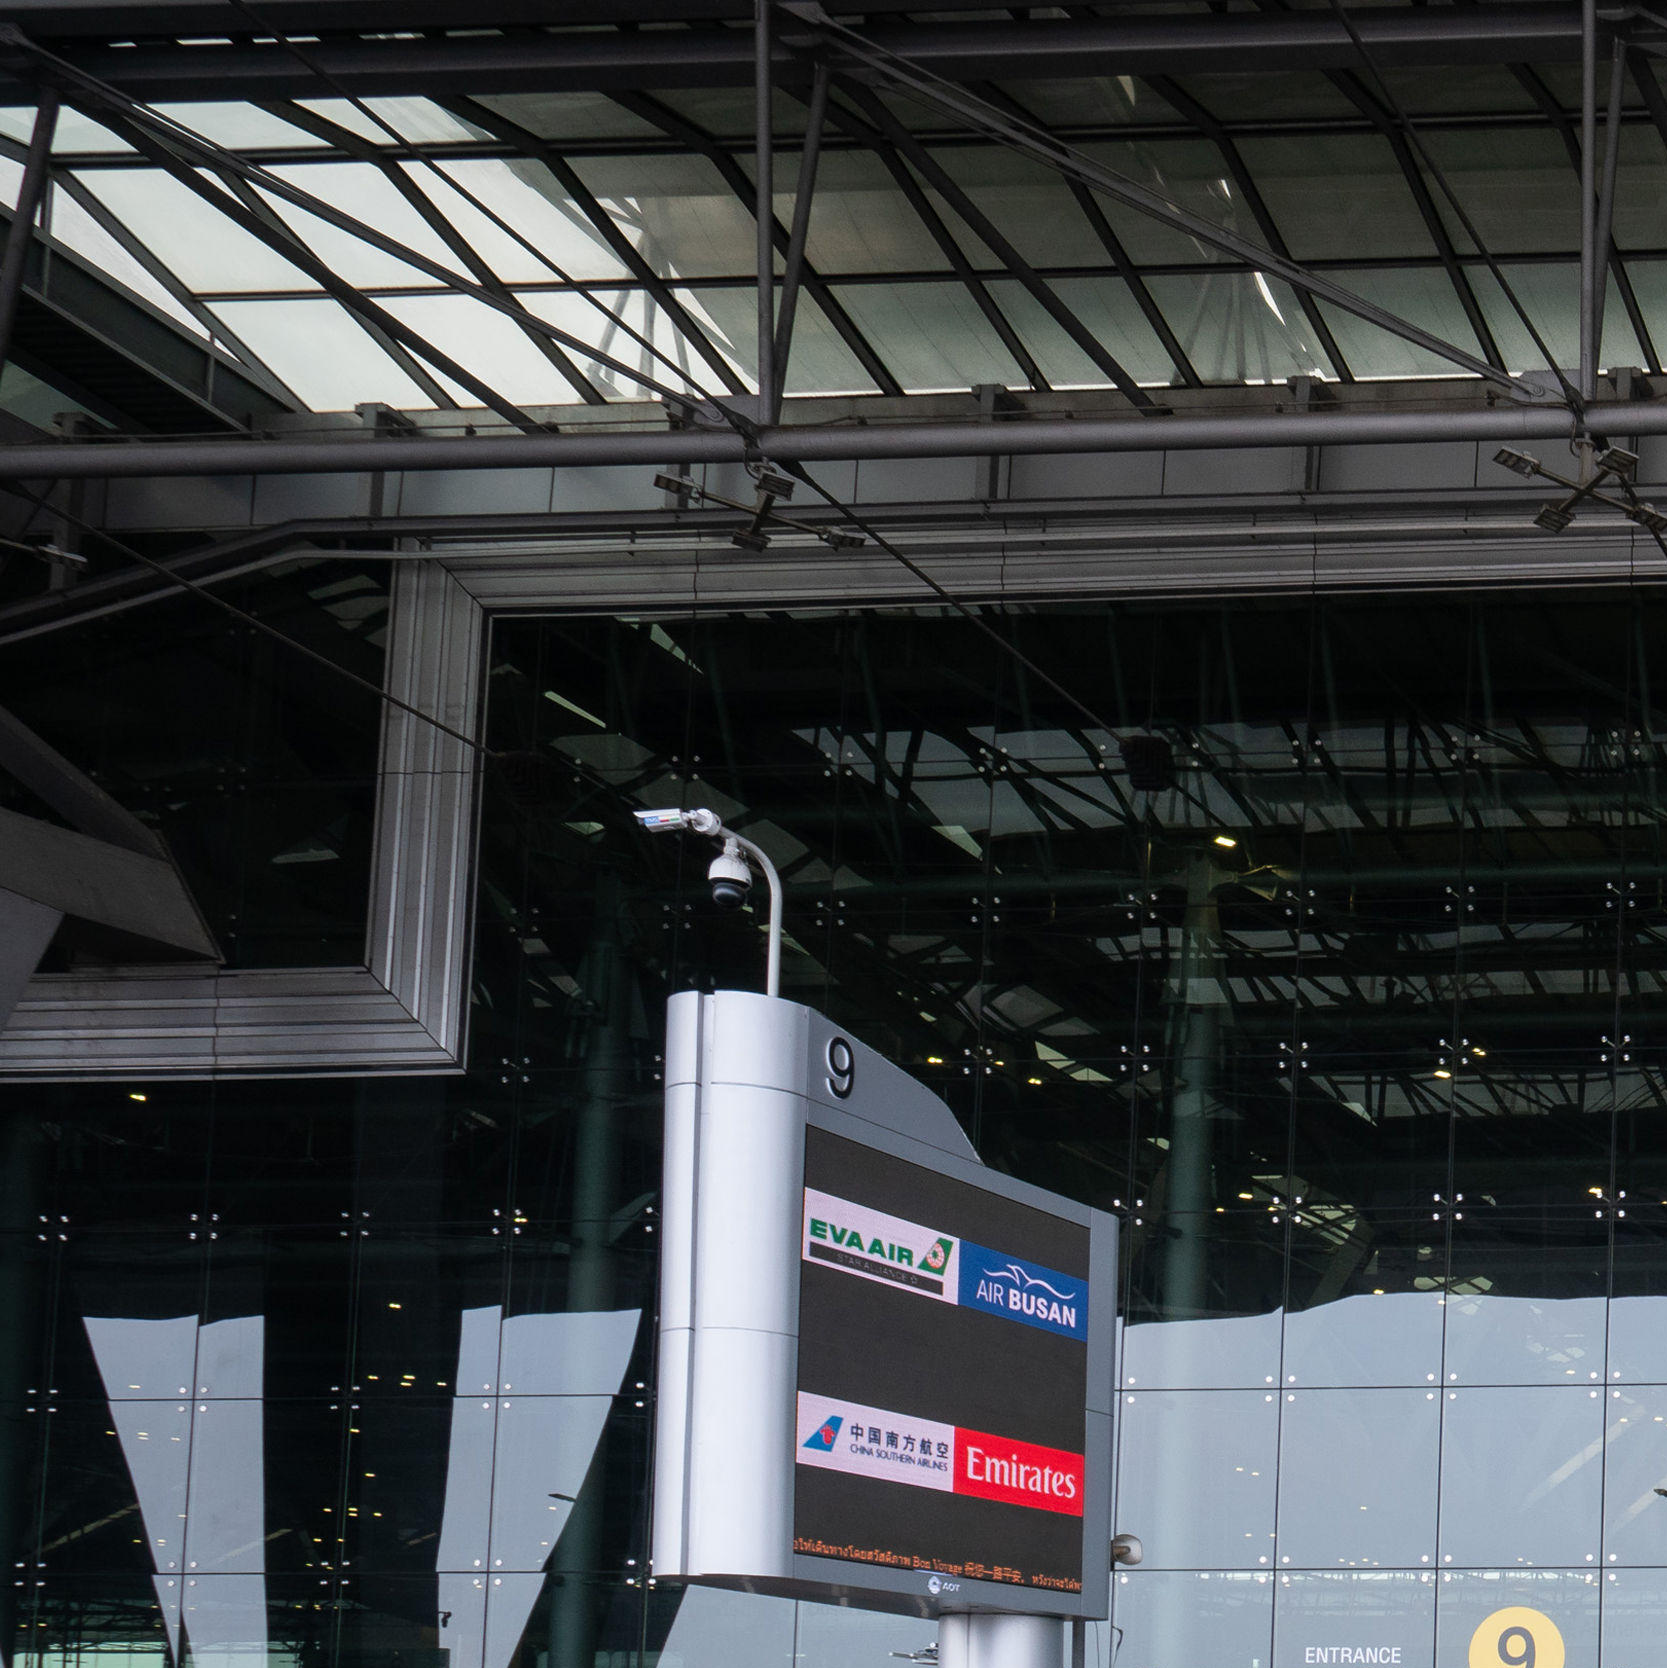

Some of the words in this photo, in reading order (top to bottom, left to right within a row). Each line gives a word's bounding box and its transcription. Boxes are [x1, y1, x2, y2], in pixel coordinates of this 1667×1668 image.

[826, 1036, 856, 1099] 9
[809, 1217, 865, 1252] EVA
[868, 1237, 914, 1267] AIR
[837, 1252, 861, 1266] STAR
[976, 1279, 1004, 1306] AIR
[1008, 1288, 1076, 1328] BUSAN
[850, 1422, 949, 1459] 中国南方航空
[849, 1444, 874, 1456] CHINA
[876, 1448, 915, 1465] SOUTHERN
[917, 1456, 948, 1472] AIRLINES
[966, 1445, 1076, 1499] Emirates
[912, 1555, 931, 1569] Bon
[932, 1558, 963, 1576] Voyage
[942, 1582, 961, 1592] AOT
[1304, 1646, 1402, 1664] ENTRANCE
